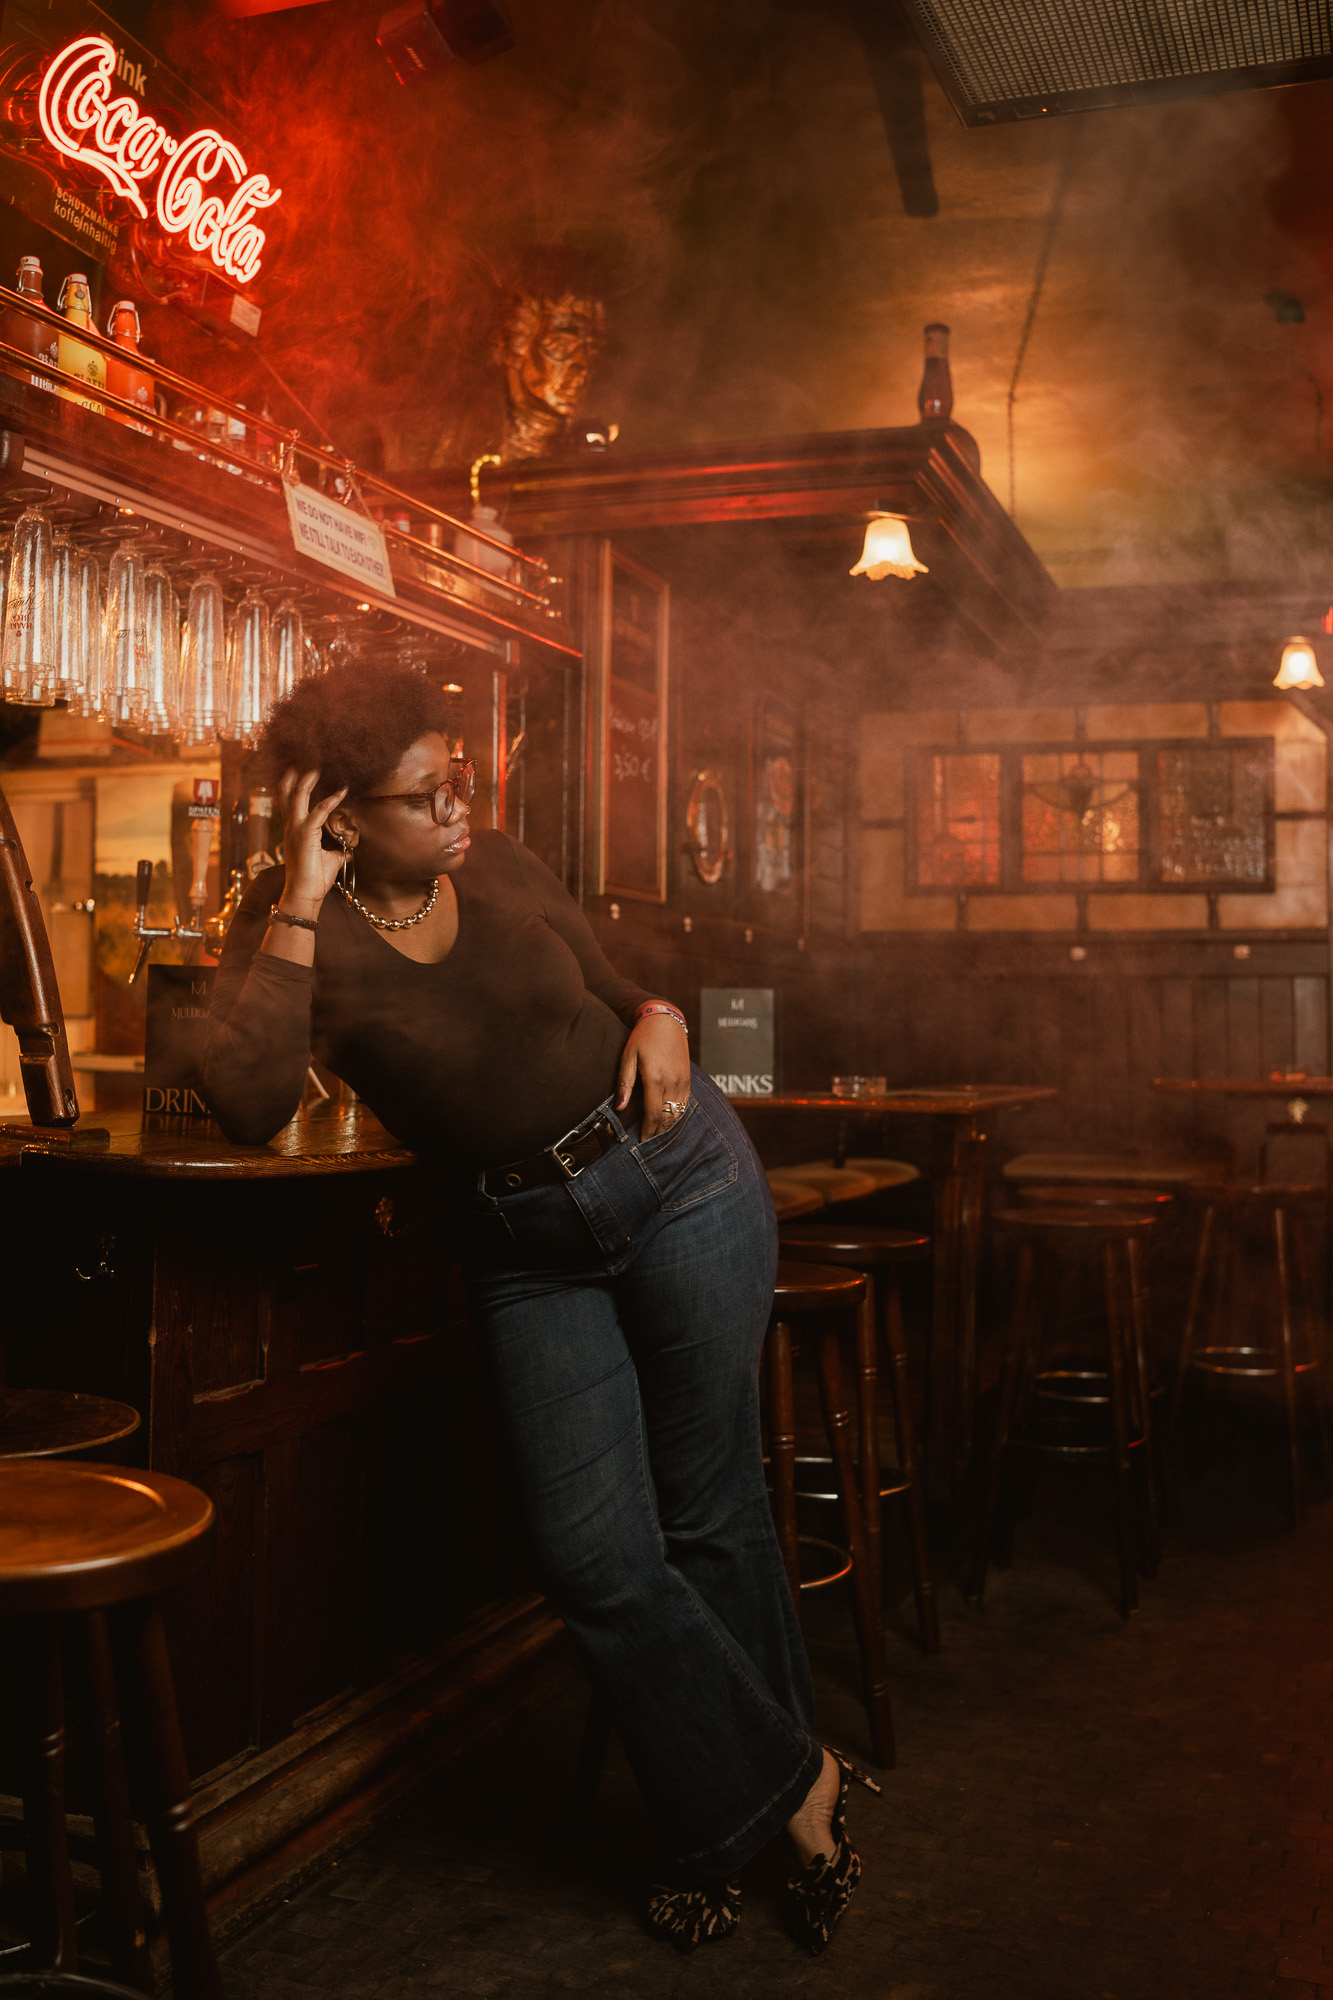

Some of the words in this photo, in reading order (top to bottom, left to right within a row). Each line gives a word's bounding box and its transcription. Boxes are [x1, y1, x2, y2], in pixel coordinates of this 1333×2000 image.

[56, 187, 119, 238] SCHUTZMARKE
[295, 497, 308, 516] WE
[318, 510, 334, 528] NOT
[333, 518, 353, 540] HAVE
[299, 521, 310, 541] WE
[191, 981, 207, 996] M
[145, 1087, 212, 1115] DRIN
